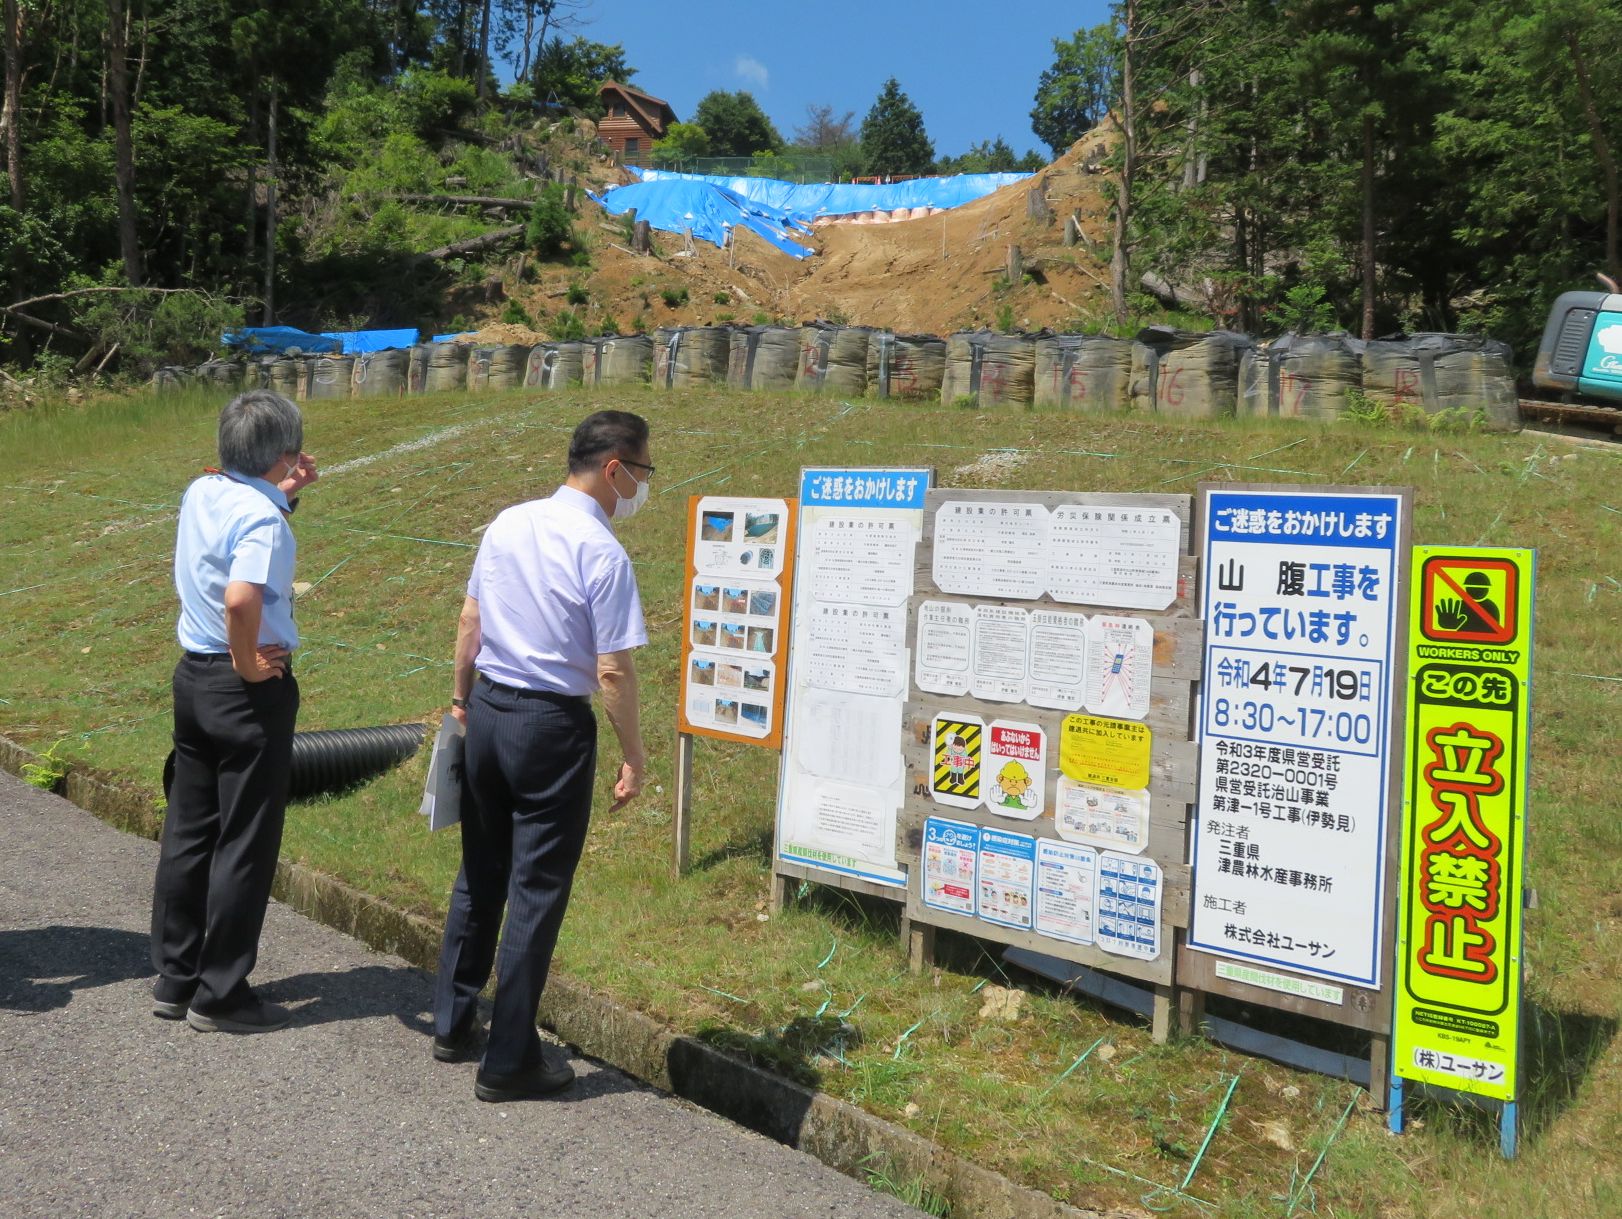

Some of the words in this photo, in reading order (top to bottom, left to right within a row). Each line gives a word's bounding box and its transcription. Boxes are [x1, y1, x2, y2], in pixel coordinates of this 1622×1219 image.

[1159, 366, 1185, 407] 16
[811, 475, 917, 502] ご迷惑をおかけします
[1215, 507, 1392, 539] ご迷惑をおかけします
[1218, 558, 1244, 591] 山
[1277, 560, 1380, 601] 腹工事を
[1214, 602, 1369, 647] 行っています。
[1418, 646, 1480, 661] WORKERS
[1482, 650, 1518, 663] ONLY
[1217, 656, 1371, 702] 令和4年7月19日
[1422, 671, 1511, 704] この先
[1000, 729, 1031, 746] あぶないから
[1068, 726, 1144, 742] 建退共に加入しています
[940, 753, 975, 769] 工事中
[990, 741, 1040, 760] はいってはいけません
[1215, 740, 1341, 772] 令和3年度県営受託
[1215, 776, 1330, 808] 県営受託治山事業
[1207, 820, 1251, 840] 発注者
[1219, 839, 1260, 861] 三重県
[1421, 726, 1498, 977] 立入禁止
[1217, 858, 1333, 894] 津農林水産事務所
[1203, 894, 1247, 916] 施工者
[1224, 922, 1336, 959] 株式会社ユーサン
[1414, 1048, 1504, 1081] (株)ユーサン
